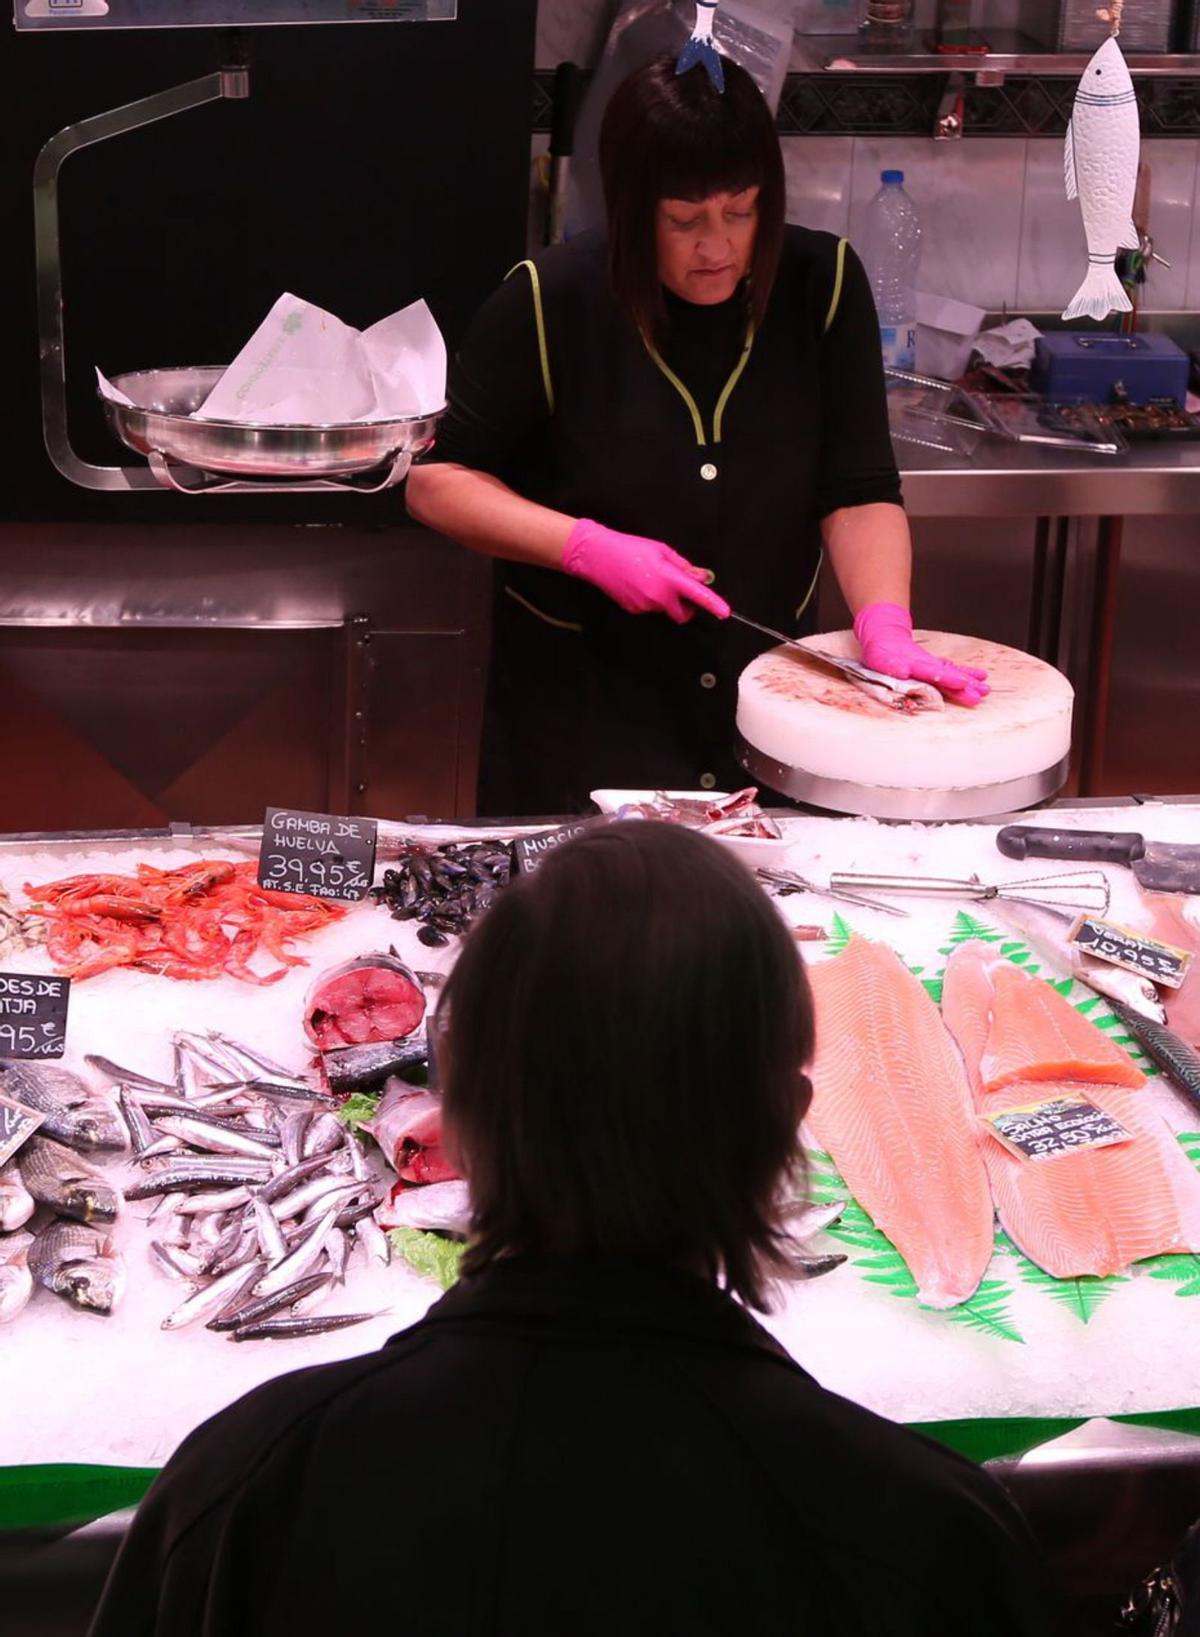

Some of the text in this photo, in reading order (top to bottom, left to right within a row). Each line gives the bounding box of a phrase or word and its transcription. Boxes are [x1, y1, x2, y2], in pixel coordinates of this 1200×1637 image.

[271, 812, 362, 839] GAMBA DE
[273, 833, 340, 855] HUELVA
[36, 981, 61, 997] DE
